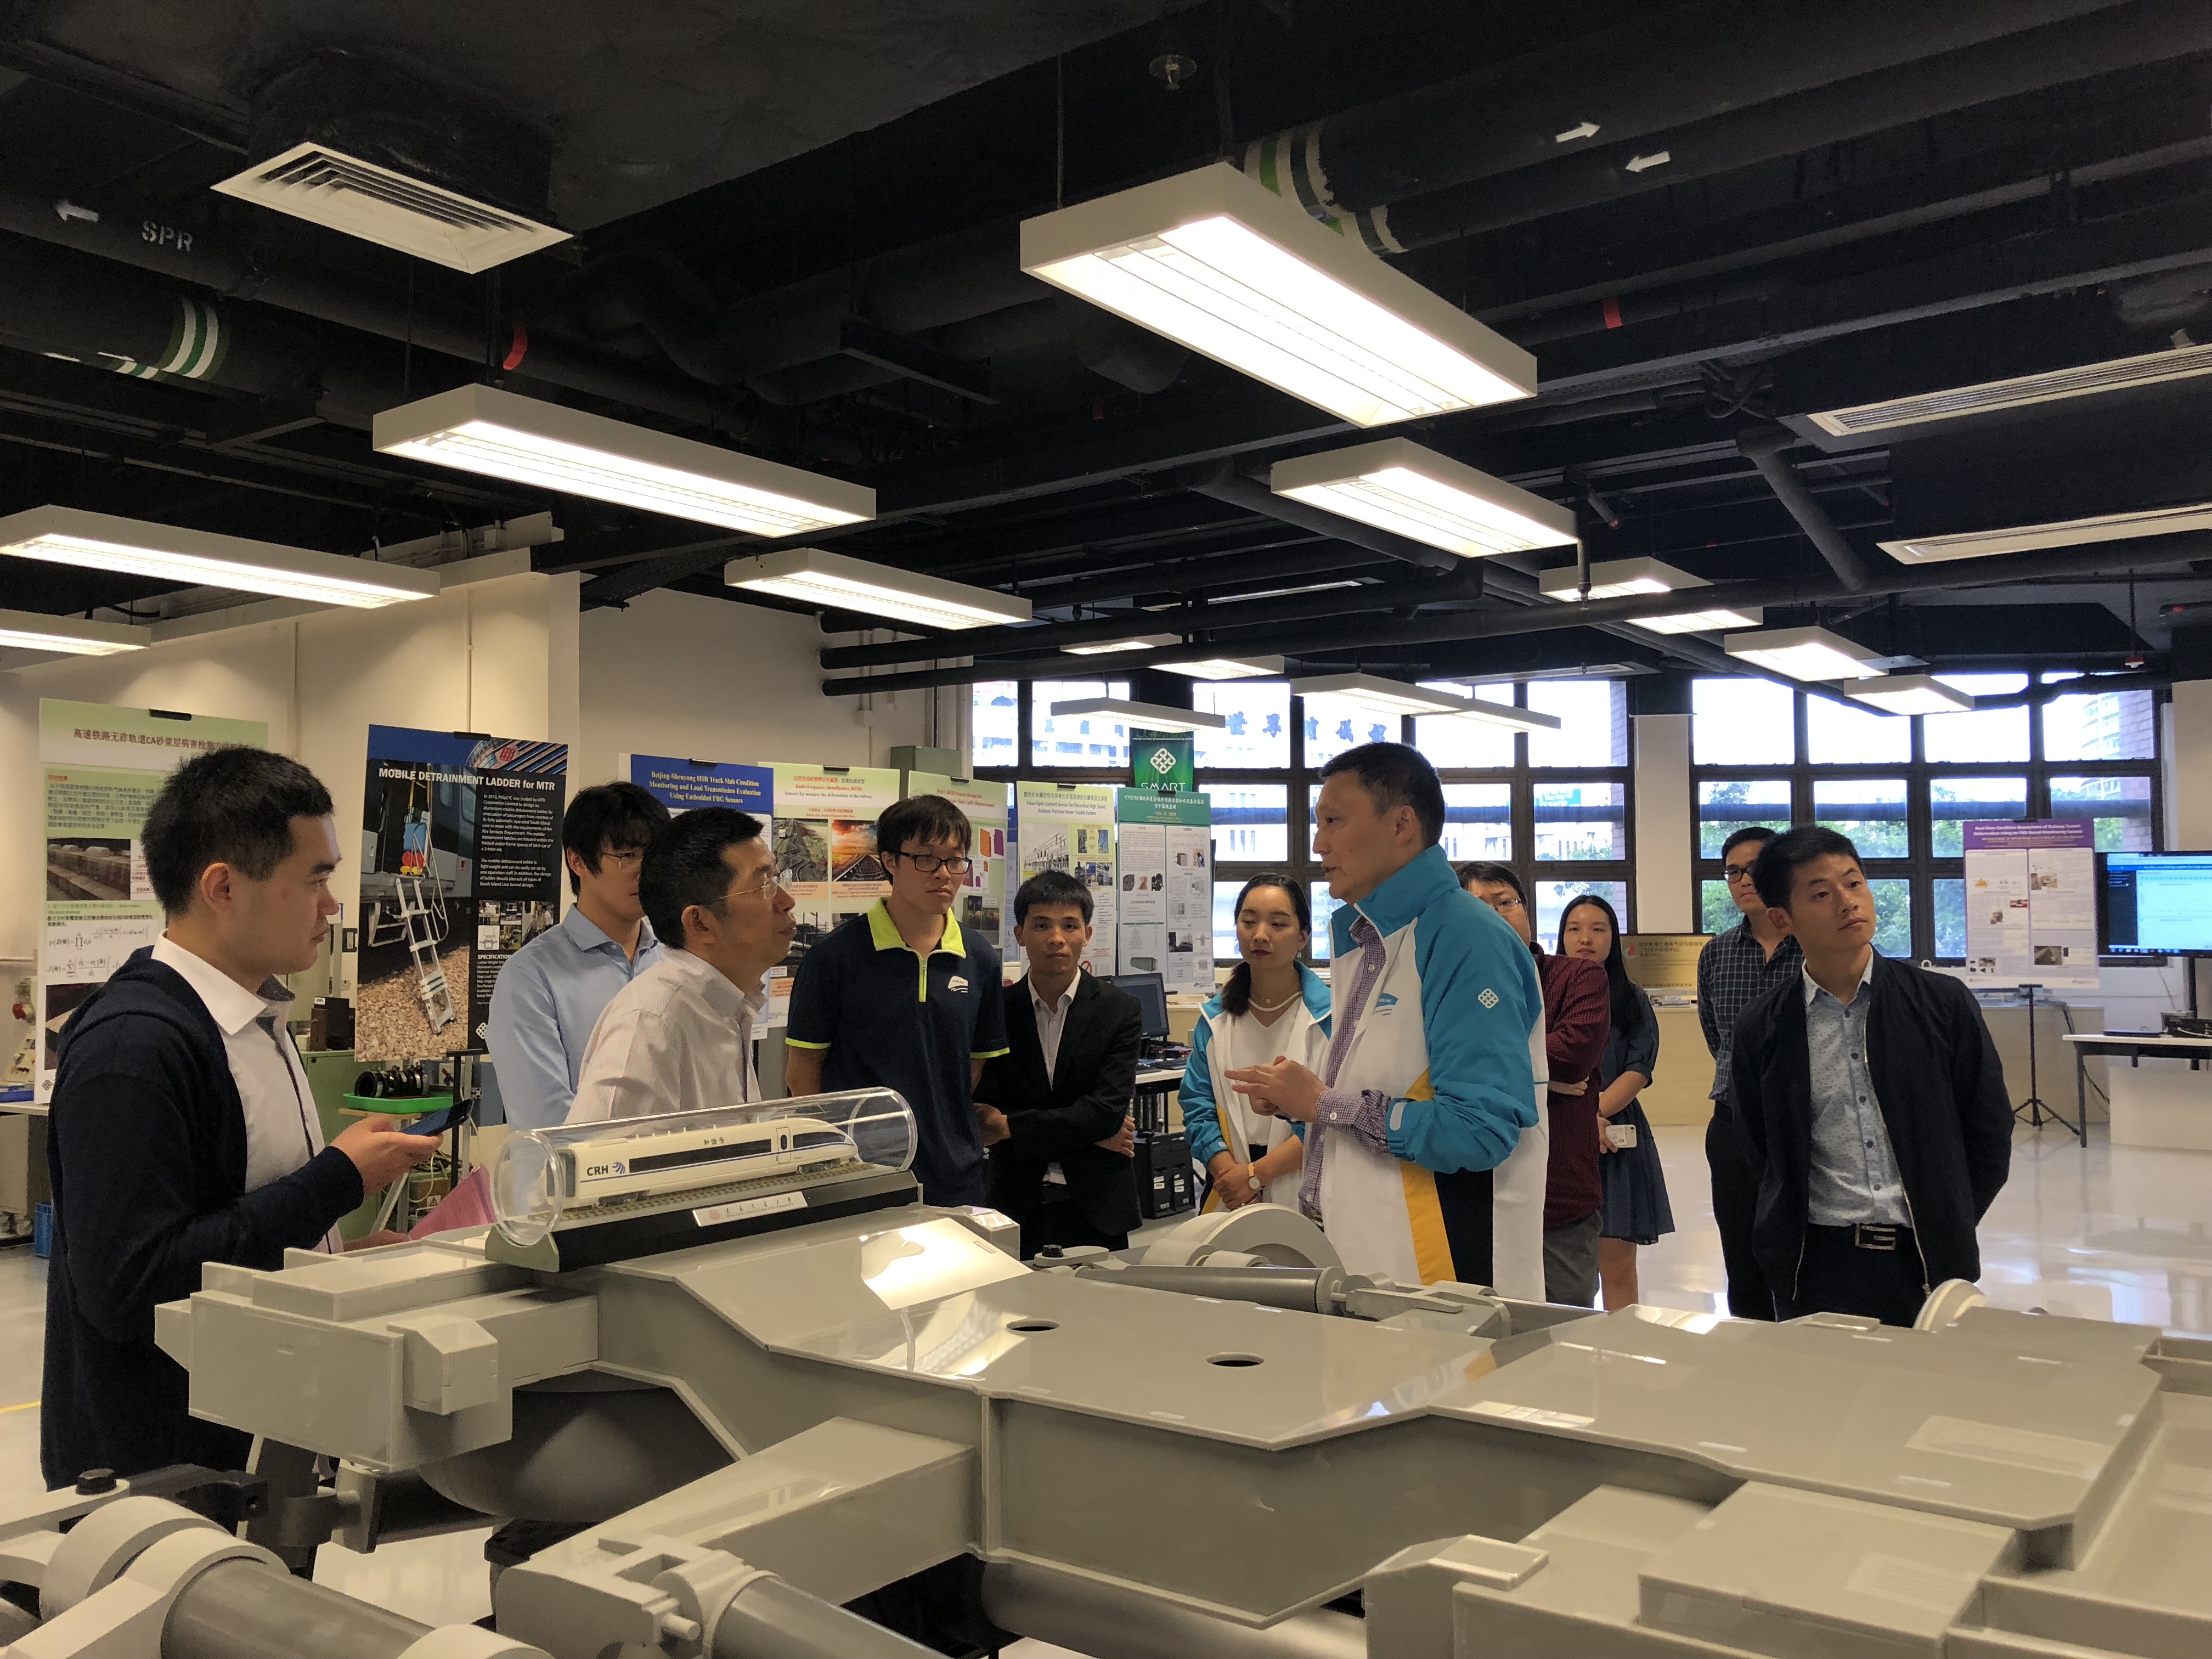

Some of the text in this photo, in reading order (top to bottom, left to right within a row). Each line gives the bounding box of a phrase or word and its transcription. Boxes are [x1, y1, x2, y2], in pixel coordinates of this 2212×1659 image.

[142, 220, 193, 252] SPR
[379, 770, 555, 790] MOBILE DETRAINMENT LADDER for MTR
[651, 771, 696, 782] Beijing-Shenyang
[649, 781, 678, 791] Monitoring
[704, 786, 735, 794] Transmission
[1141, 782, 1186, 791] SMART
[670, 792, 684, 800] Using
[704, 1137, 725, 1146] 和谐号
[586, 1165, 608, 1176] CRH
